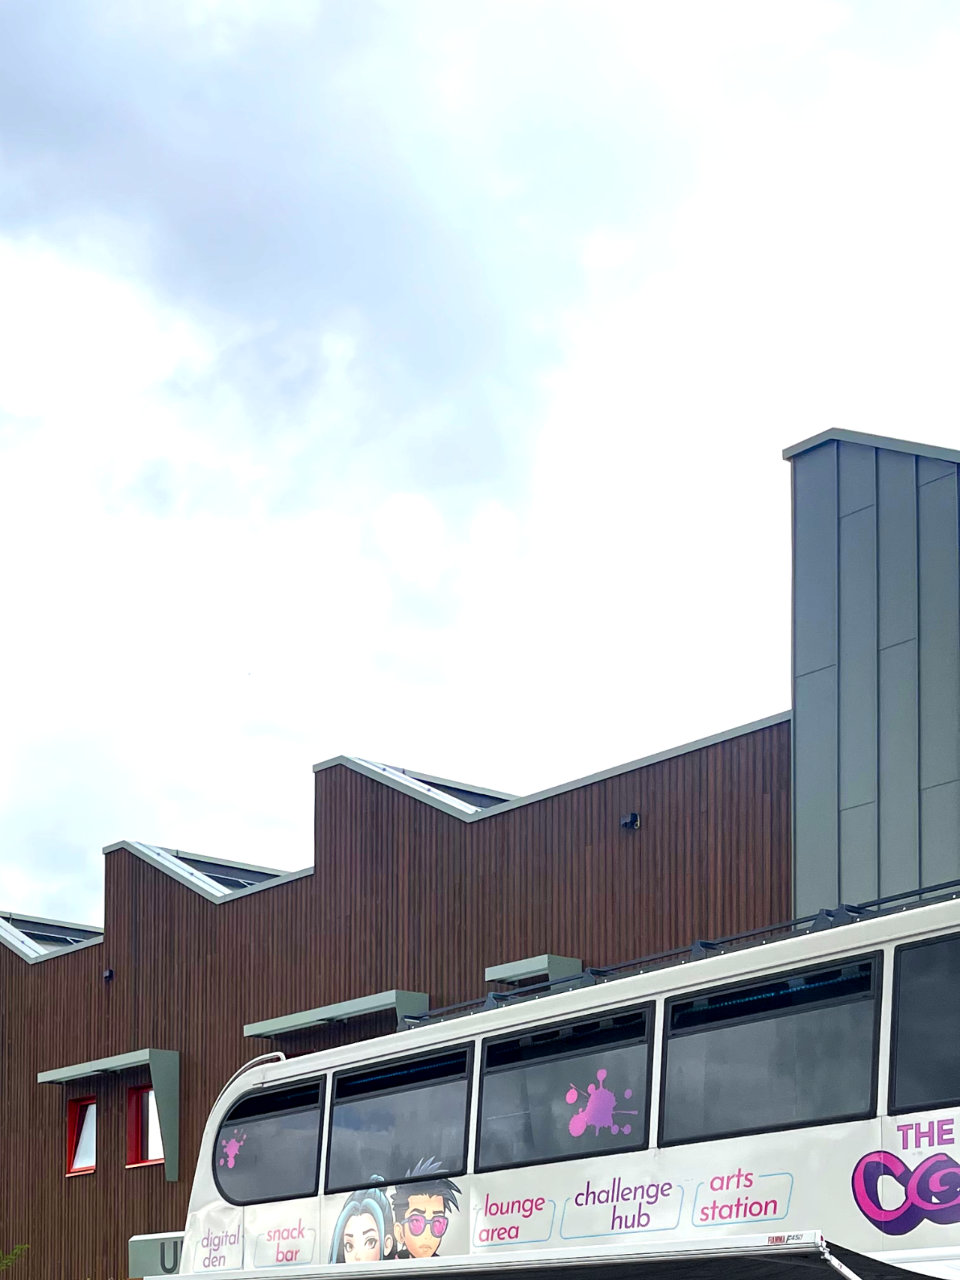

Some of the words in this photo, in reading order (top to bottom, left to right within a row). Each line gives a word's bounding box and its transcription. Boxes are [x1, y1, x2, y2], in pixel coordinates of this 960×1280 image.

[897, 1118, 955, 1150] THE
[574, 1177, 672, 1206] challenge
[710, 1168, 753, 1191] arts
[484, 1193, 545, 1218] lounge
[611, 1202, 651, 1230] hub
[699, 1196, 778, 1222] station
[201, 1225, 241, 1251] digital
[267, 1218, 306, 1242] snack
[478, 1226, 519, 1242] area
[160, 1240, 183, 1274] U
[203, 1248, 226, 1268] den
[276, 1243, 300, 1263] bar
